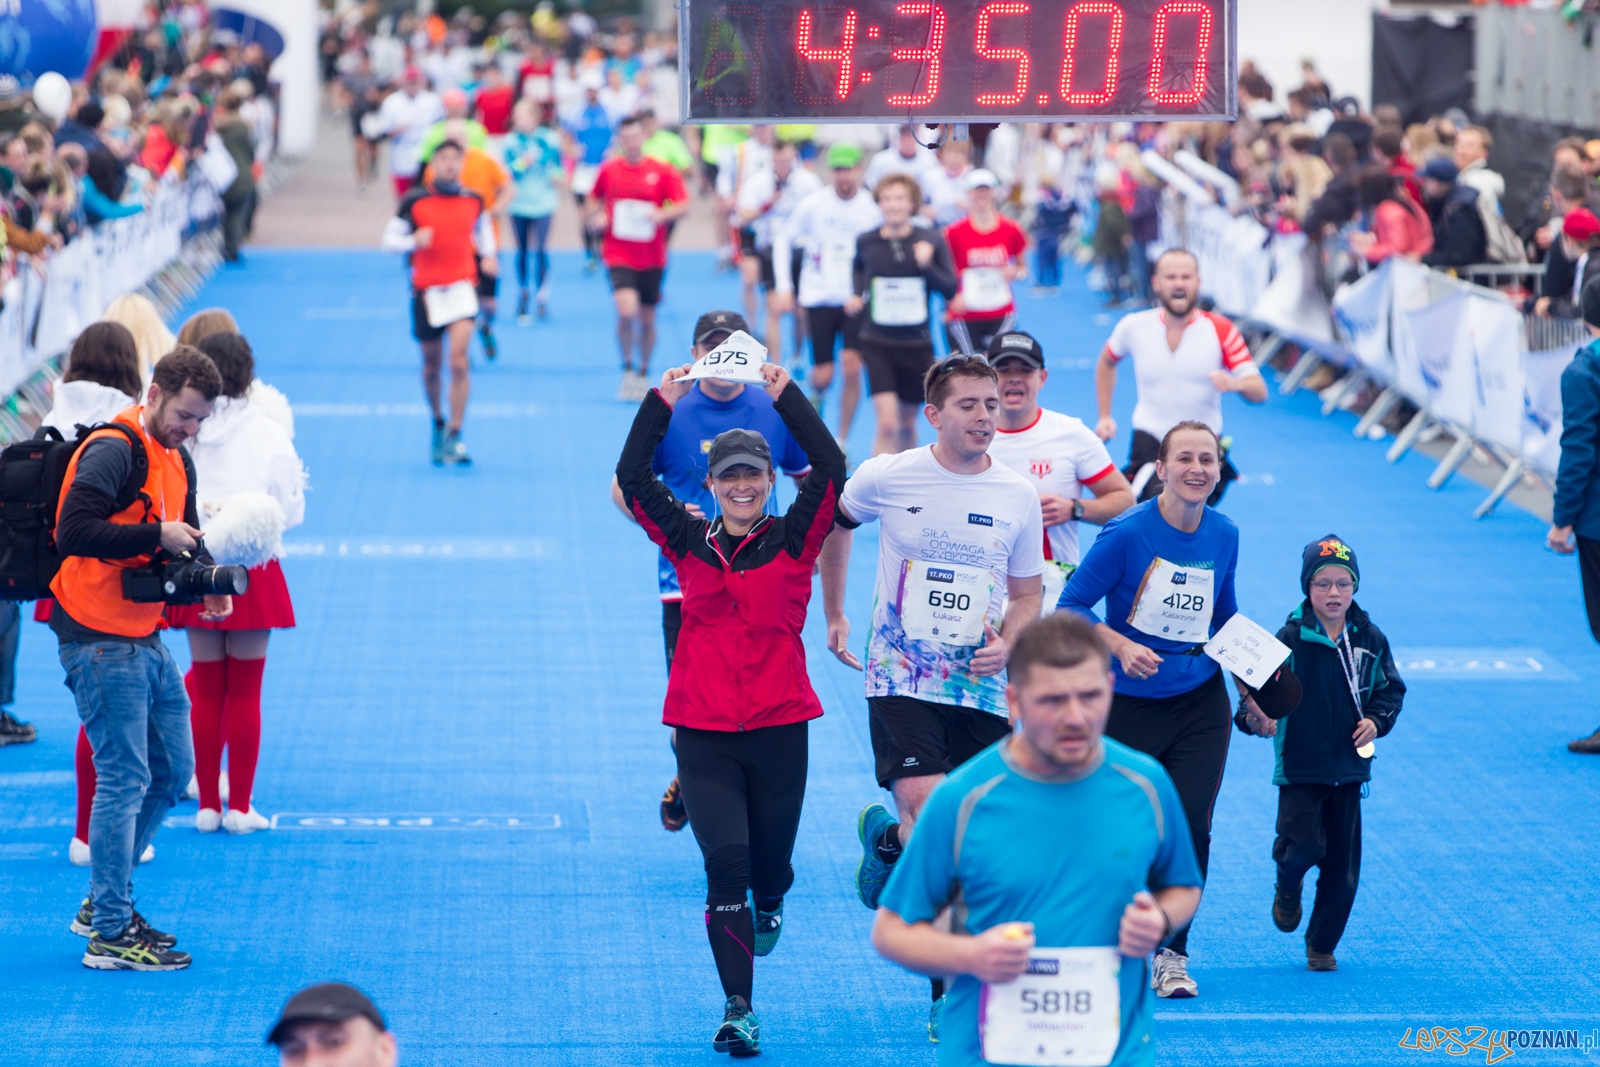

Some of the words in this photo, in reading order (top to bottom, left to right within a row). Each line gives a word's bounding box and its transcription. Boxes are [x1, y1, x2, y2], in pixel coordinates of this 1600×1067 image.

[703, 351, 748, 365] 1975
[922, 527, 950, 539] SIŁA
[929, 539, 985, 555] ODWAGA
[928, 590, 971, 611] 690
[1162, 592, 1204, 612] 4128
[932, 611, 962, 622] Łukasz
[1161, 610, 1197, 622] Katarzyna
[1020, 988, 1092, 1015] 5818
